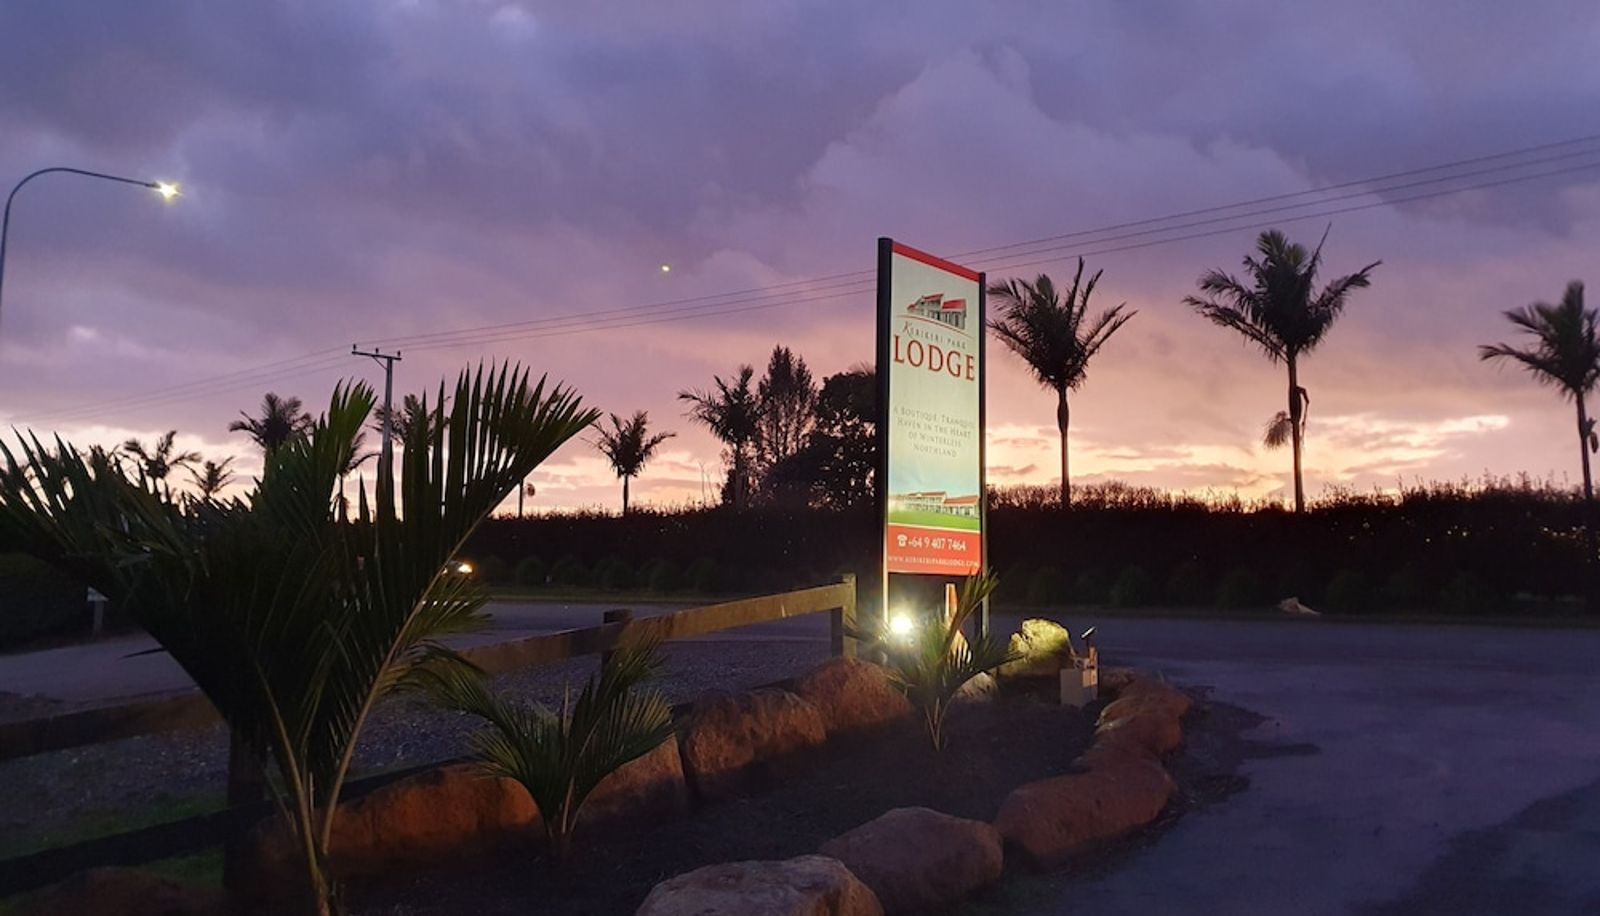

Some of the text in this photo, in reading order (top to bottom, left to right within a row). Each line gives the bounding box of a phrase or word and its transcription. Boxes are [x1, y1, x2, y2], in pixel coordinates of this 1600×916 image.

[947, 338, 966, 350] PARK
[894, 335, 975, 381] LODGE
[950, 427, 971, 438] HEART
[908, 536, 966, 551] +64 9 407 7464
